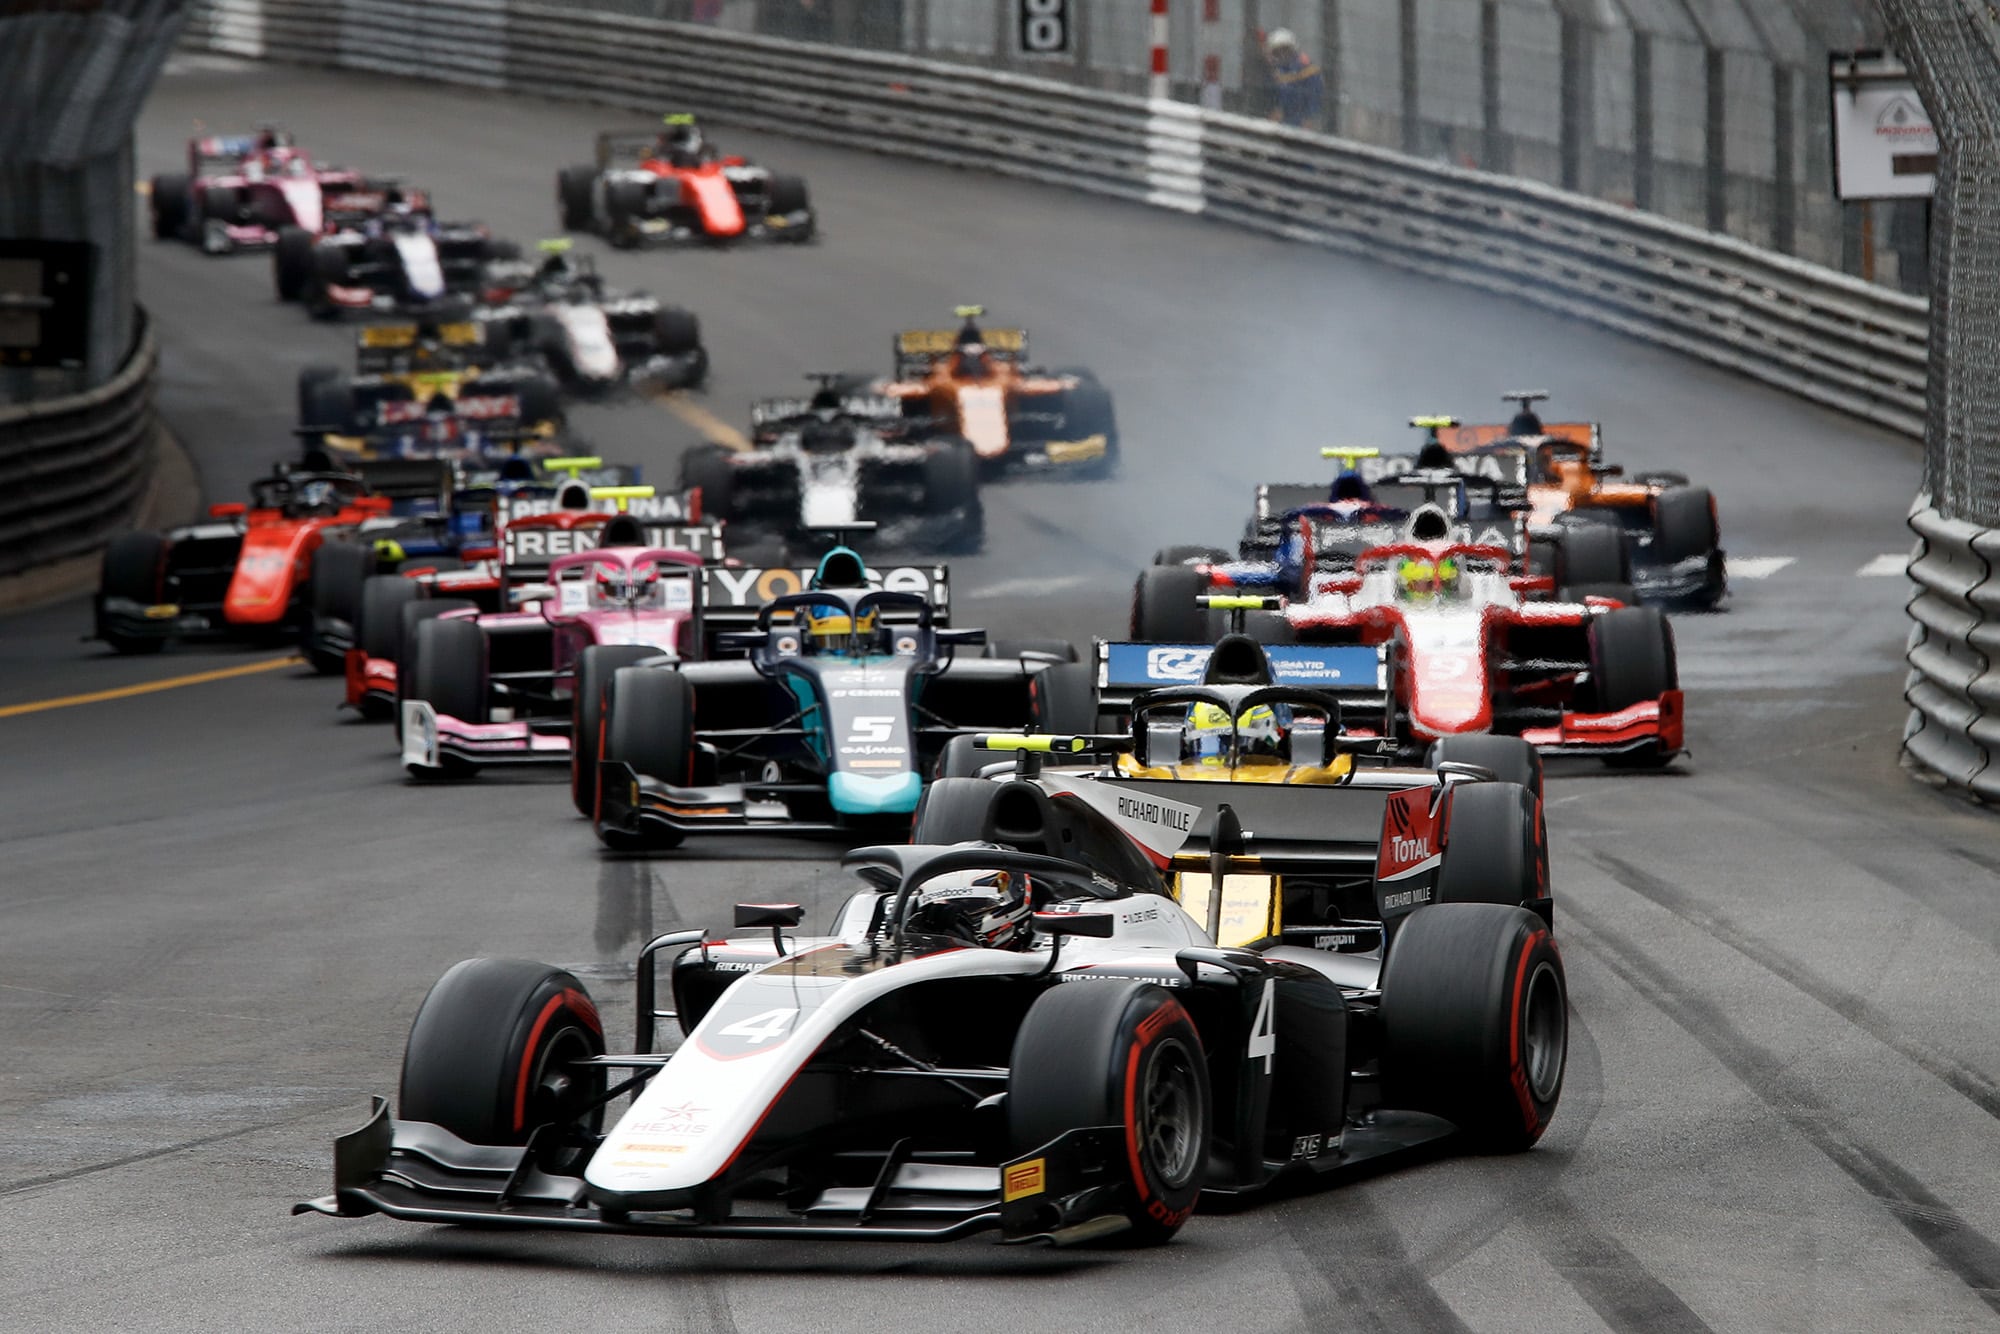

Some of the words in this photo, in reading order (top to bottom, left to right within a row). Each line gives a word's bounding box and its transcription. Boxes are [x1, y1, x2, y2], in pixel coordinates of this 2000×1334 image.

[516, 528, 709, 554] RENULT
[847, 716, 896, 742] 5
[1118, 796, 1159, 824] RICHARD
[1160, 807, 1190, 832] MILLE
[1392, 835, 1431, 863] TOTAL
[1384, 891, 1412, 909] RICHARD
[1412, 886, 1432, 903] MILLE
[717, 1008, 800, 1043] 4
[1247, 978, 1276, 1075] 4
[631, 1122, 709, 1133] HEXIS
[1006, 1165, 1041, 1195] PIRELLI
